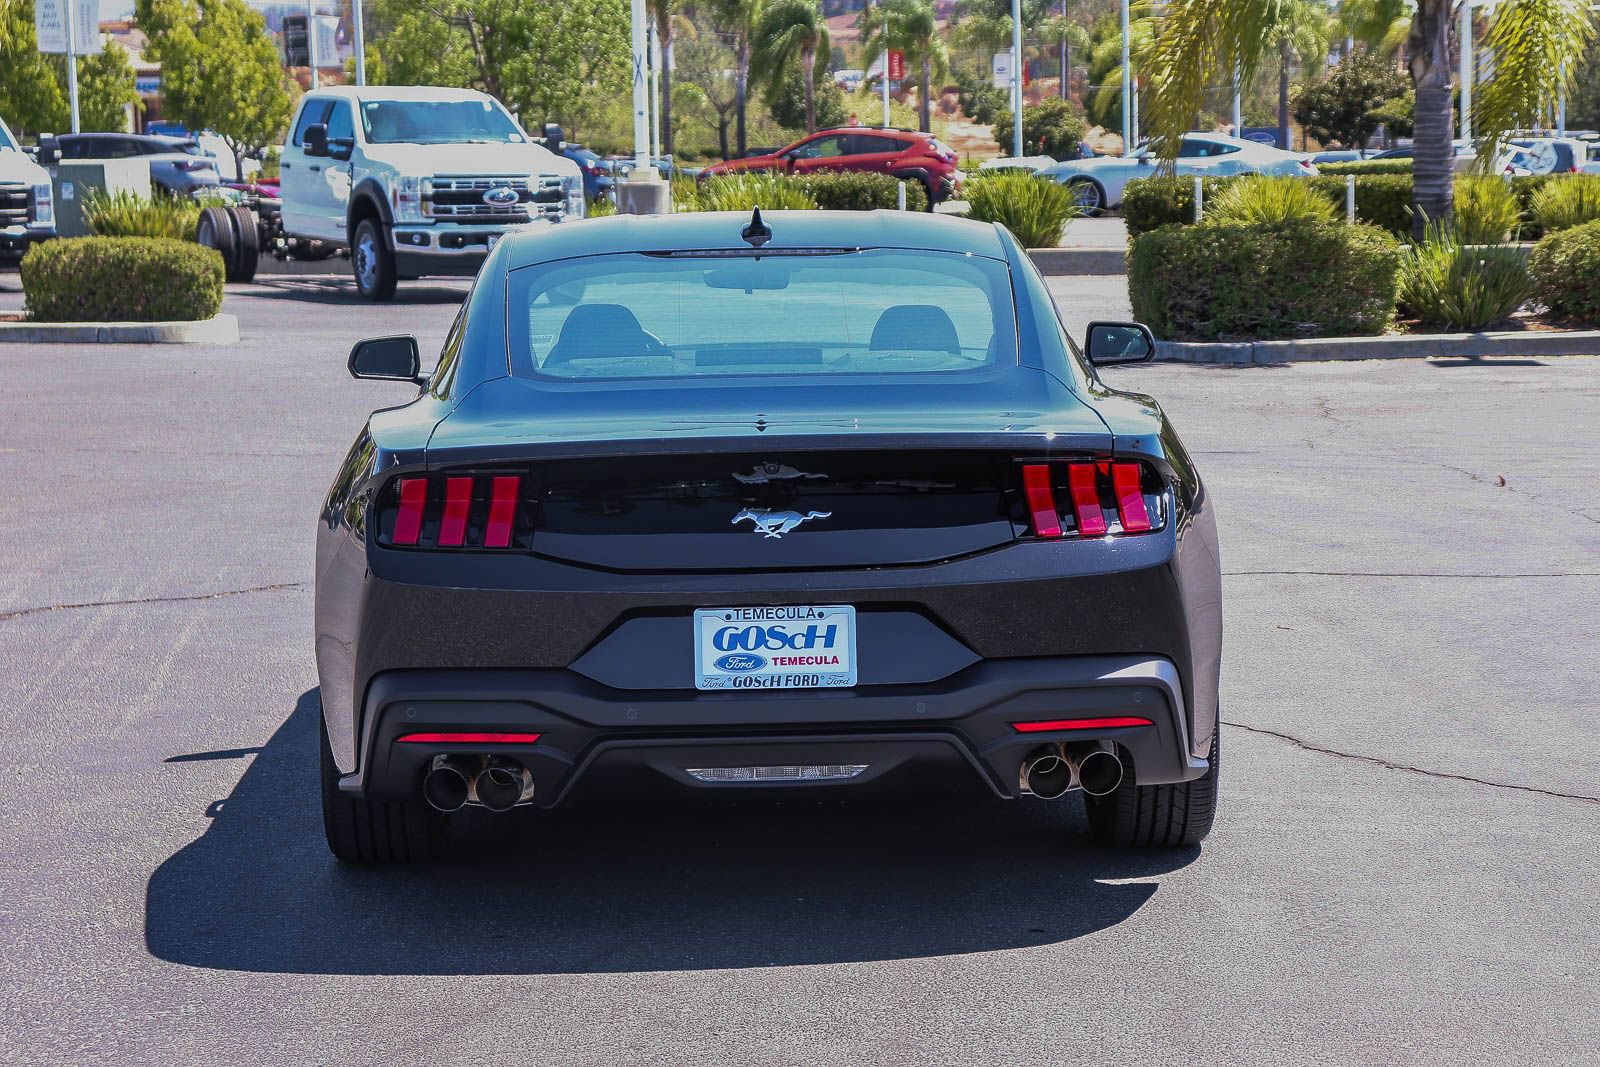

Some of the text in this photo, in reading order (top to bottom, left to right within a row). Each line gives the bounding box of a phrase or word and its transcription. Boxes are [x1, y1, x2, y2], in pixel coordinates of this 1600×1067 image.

[733, 607, 816, 620] TEMECULA
[725, 656, 755, 669] Ford
[772, 656, 840, 666] TEMECULA
[702, 677, 726, 688] Ford
[785, 674, 819, 687] FORD
[826, 674, 850, 686] Ford
